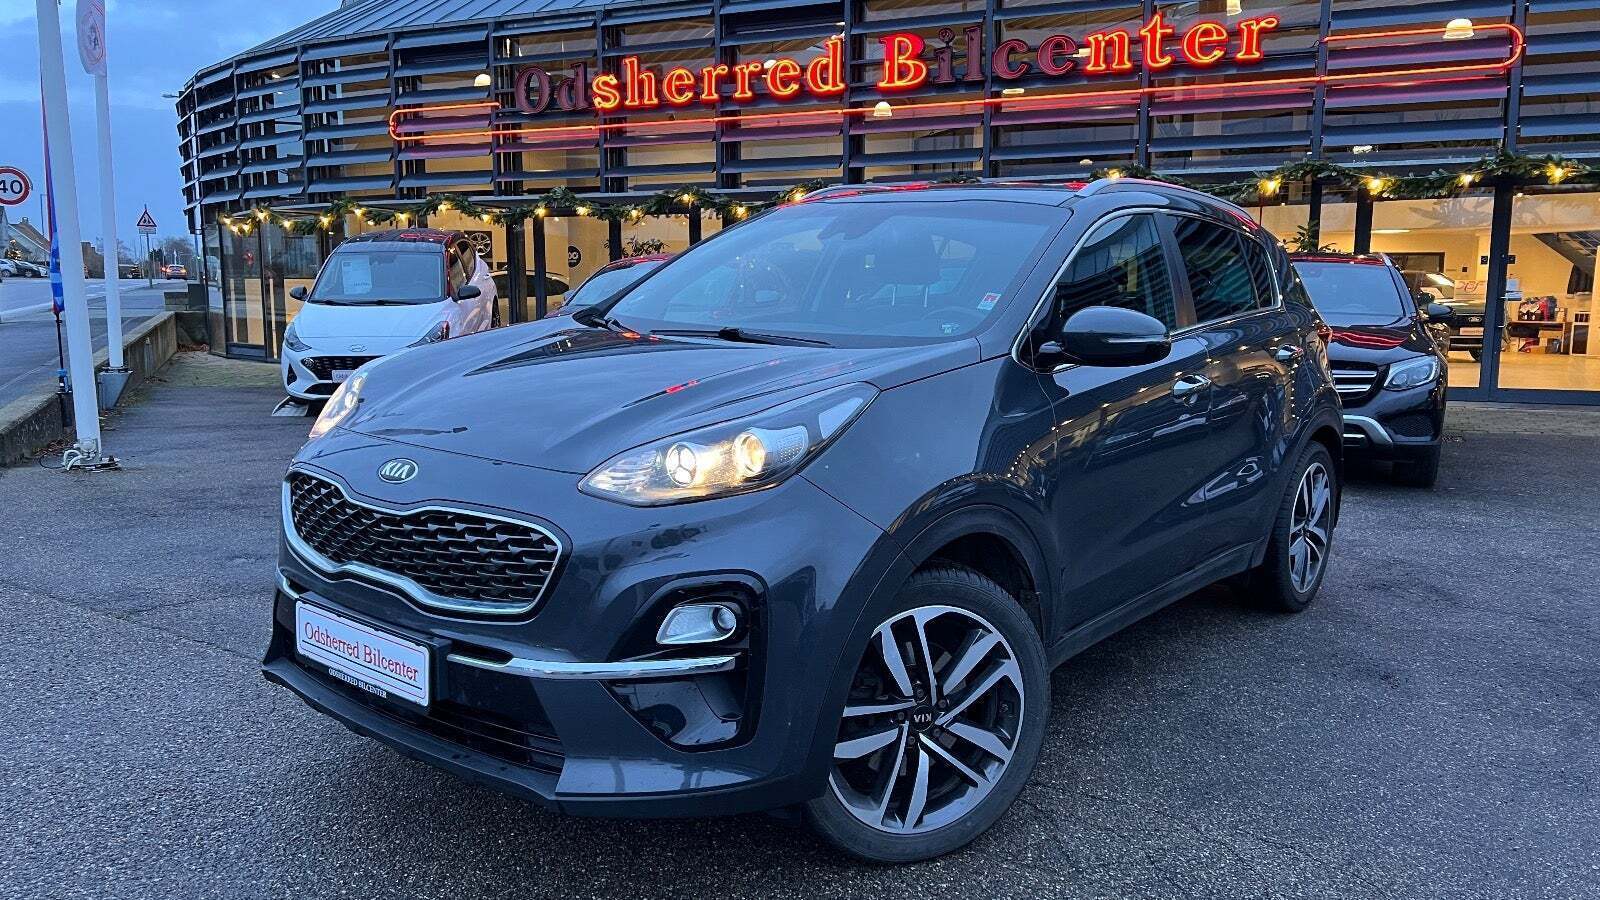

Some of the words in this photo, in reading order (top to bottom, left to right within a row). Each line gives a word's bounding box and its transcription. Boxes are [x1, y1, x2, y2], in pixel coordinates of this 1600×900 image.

[514, 36, 845, 114] Odsherred
[879, 15, 1279, 89] Bilcenter
[0, 179, 23, 194] 40
[381, 461, 411, 479] KIA
[304, 622, 360, 659] Odsherred
[363, 643, 419, 682] Bilcenter
[358, 680, 387, 699] BILCENTER
